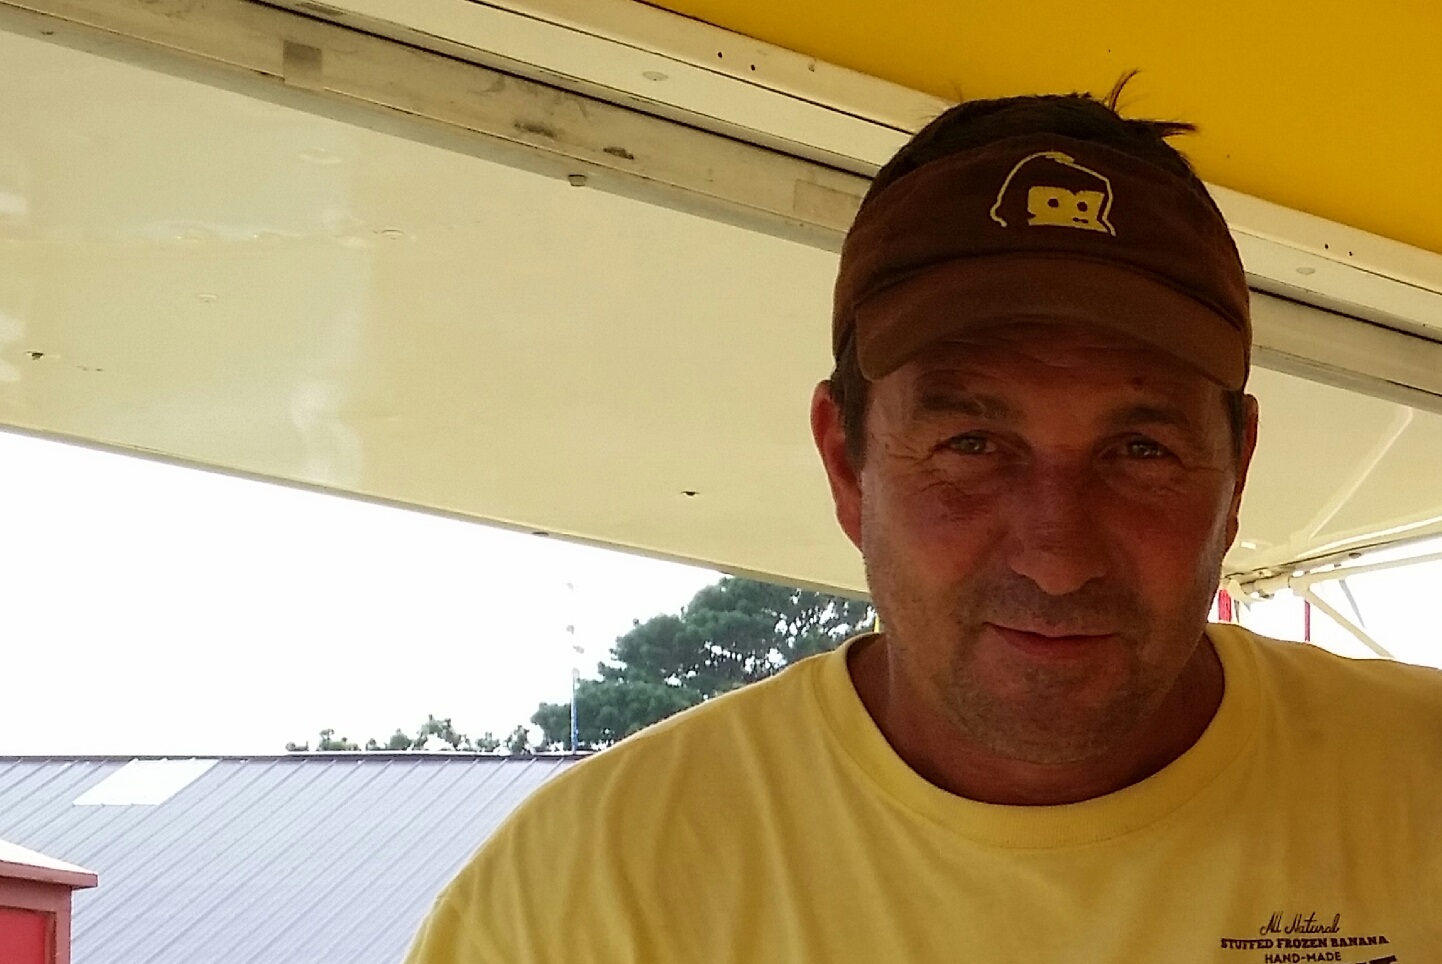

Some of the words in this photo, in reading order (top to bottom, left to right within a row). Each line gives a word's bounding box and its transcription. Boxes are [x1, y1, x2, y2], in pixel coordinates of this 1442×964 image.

[1260, 911, 1281, 935] All
[1285, 911, 1341, 934] Natural
[1220, 938, 1274, 950] STUFFED
[1276, 938, 1328, 949] FROZEN
[1330, 936, 1390, 948] BANANA
[1264, 952, 1342, 964] HAND-MADE
